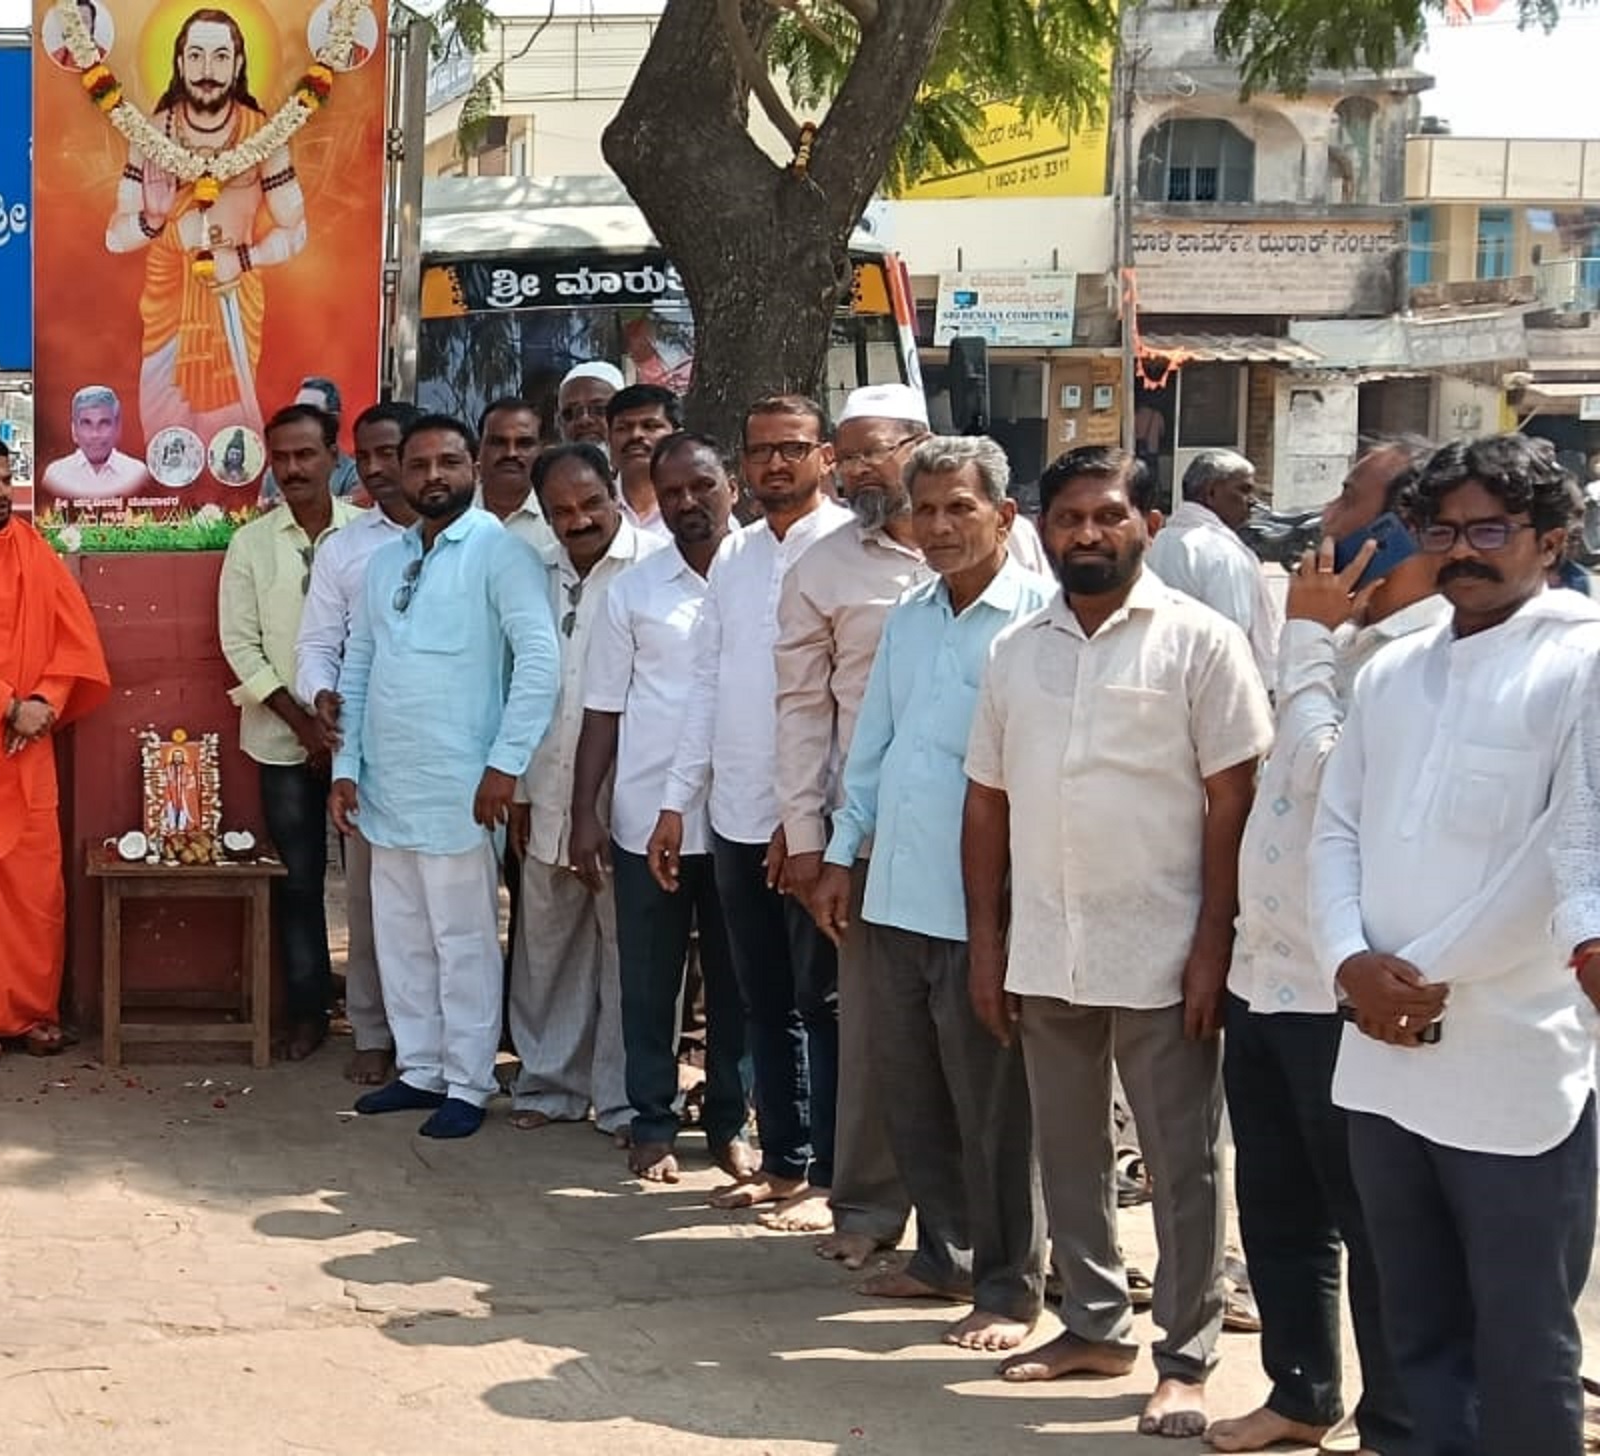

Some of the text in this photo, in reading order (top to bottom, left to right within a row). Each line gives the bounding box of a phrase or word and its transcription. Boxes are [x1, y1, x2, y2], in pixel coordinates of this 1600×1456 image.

[1020, 164, 1039, 183] 210
[1043, 157, 1069, 179] 3311
[487, 269, 540, 307] ಶ್ರೀ
[1005, 311, 1069, 320] COMPUTERS
